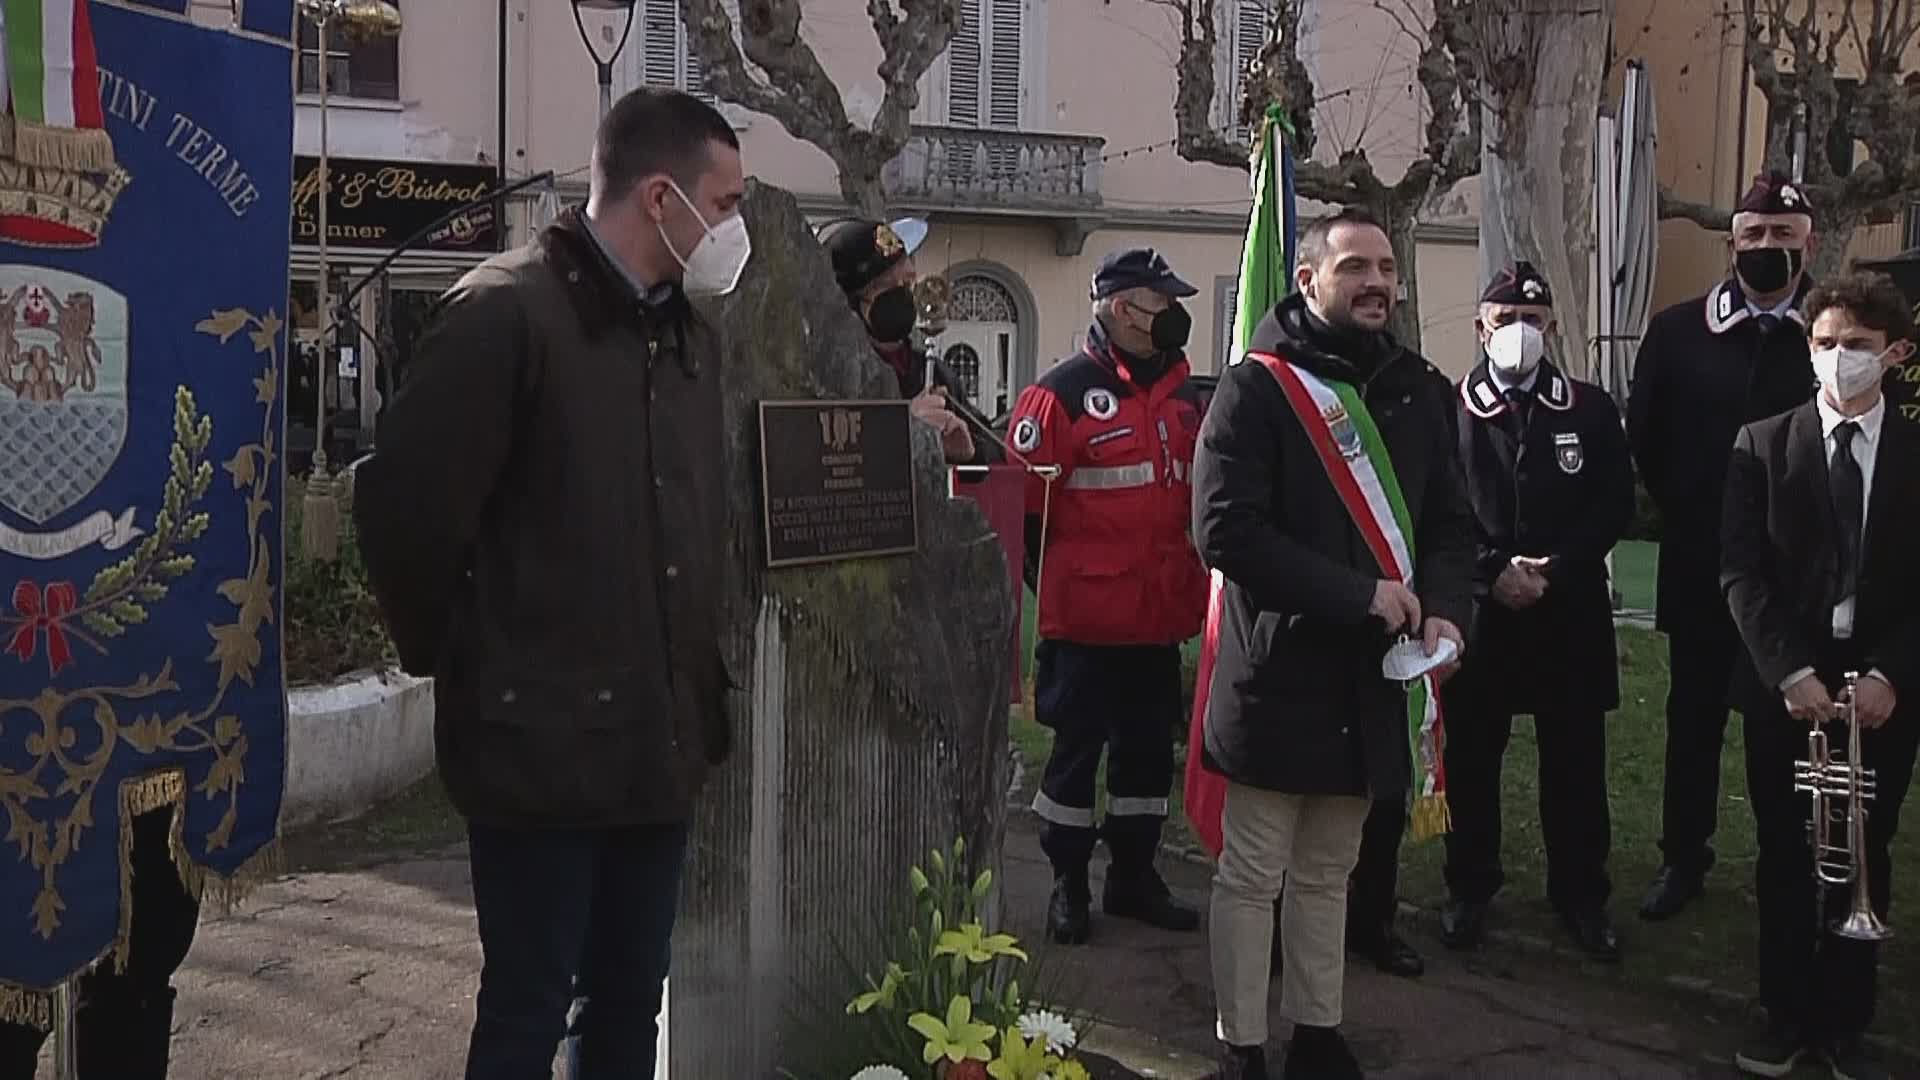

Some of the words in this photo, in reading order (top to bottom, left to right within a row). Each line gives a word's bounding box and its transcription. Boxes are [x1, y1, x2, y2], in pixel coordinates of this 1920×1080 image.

[166, 113, 260, 216] TERME
[376, 167, 486, 200] Bistrot
[298, 221, 386, 238] Dnner
